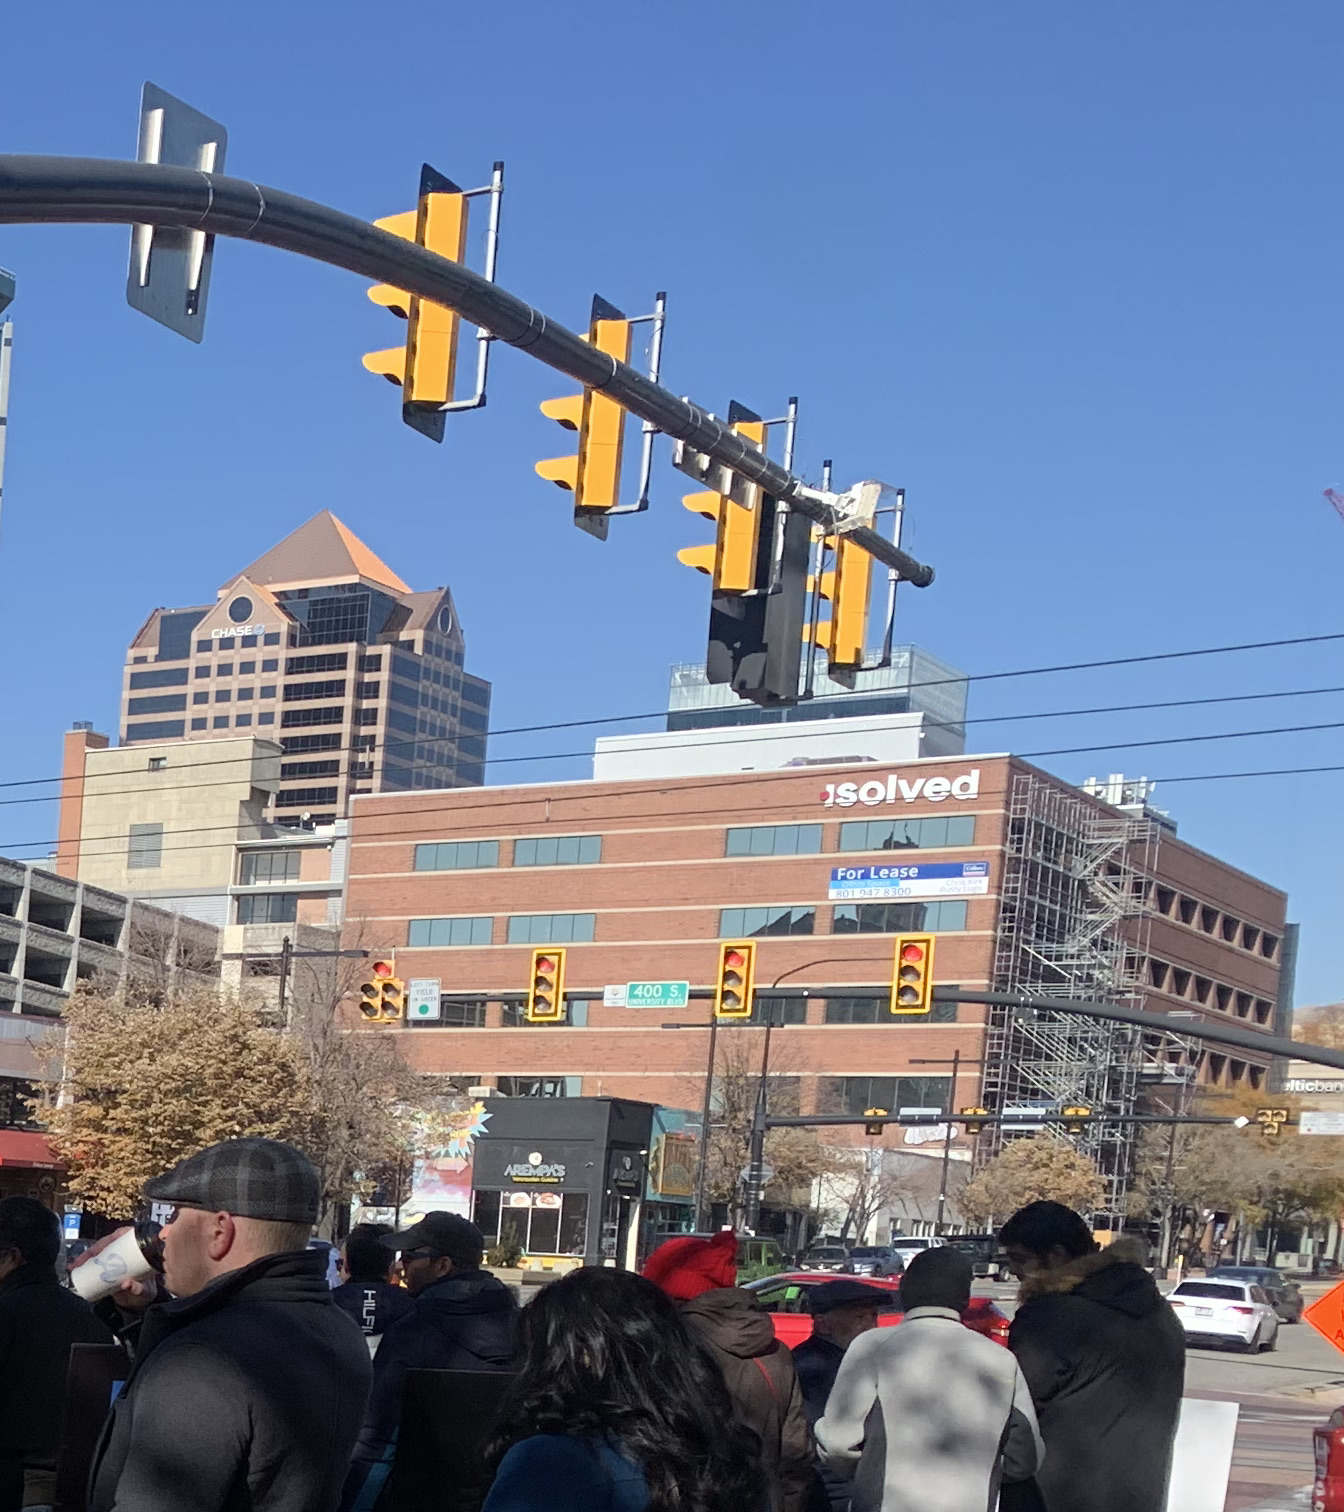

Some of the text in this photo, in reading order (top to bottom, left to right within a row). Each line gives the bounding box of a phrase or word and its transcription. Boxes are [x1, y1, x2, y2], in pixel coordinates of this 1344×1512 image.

[212, 625, 253, 638] CHASE
[819, 769, 980, 807] isolved
[837, 865, 919, 880] For Lease
[835, 887, 912, 898] 801 947 8300
[633, 984, 682, 998] 400 S.
[504, 1164, 565, 1176] AREMPA'S
[362, 1290, 376, 1332] HILFI
